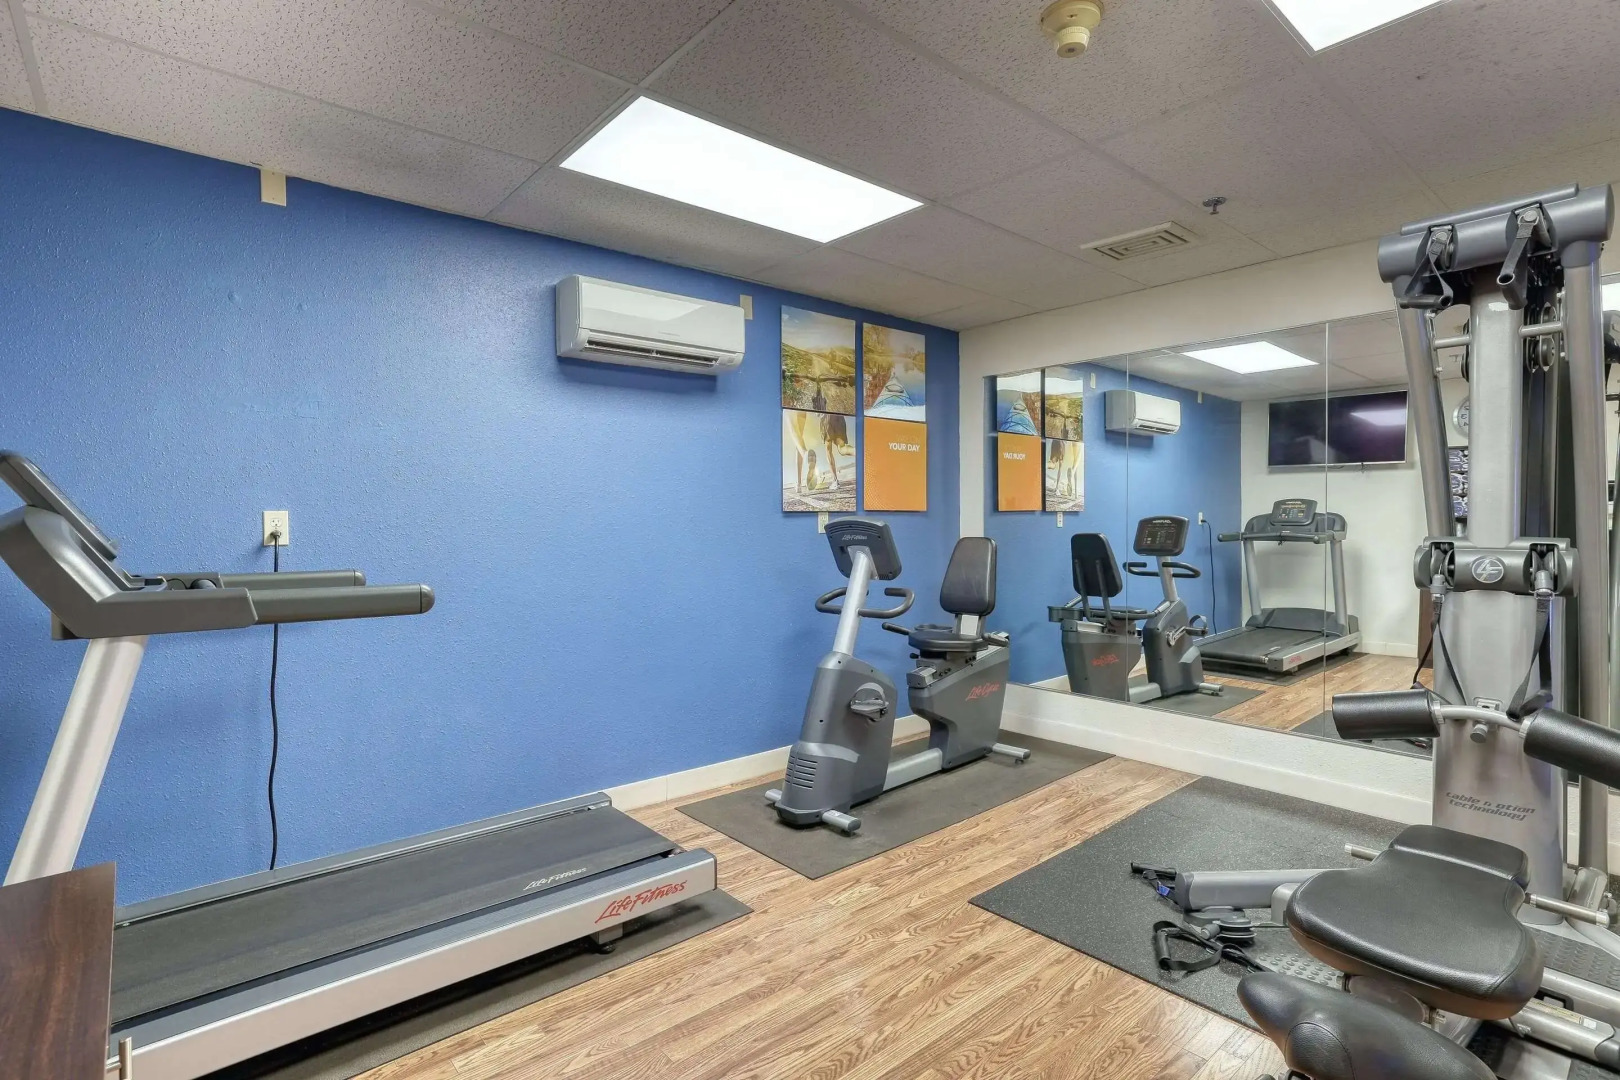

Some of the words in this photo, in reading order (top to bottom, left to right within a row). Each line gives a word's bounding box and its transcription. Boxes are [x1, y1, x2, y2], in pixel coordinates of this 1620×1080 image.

[888, 441, 907, 451] YOUR
[907, 443, 921, 453] DAY
[1446, 791, 1481, 804] cable
[1449, 799, 1527, 821] technology
